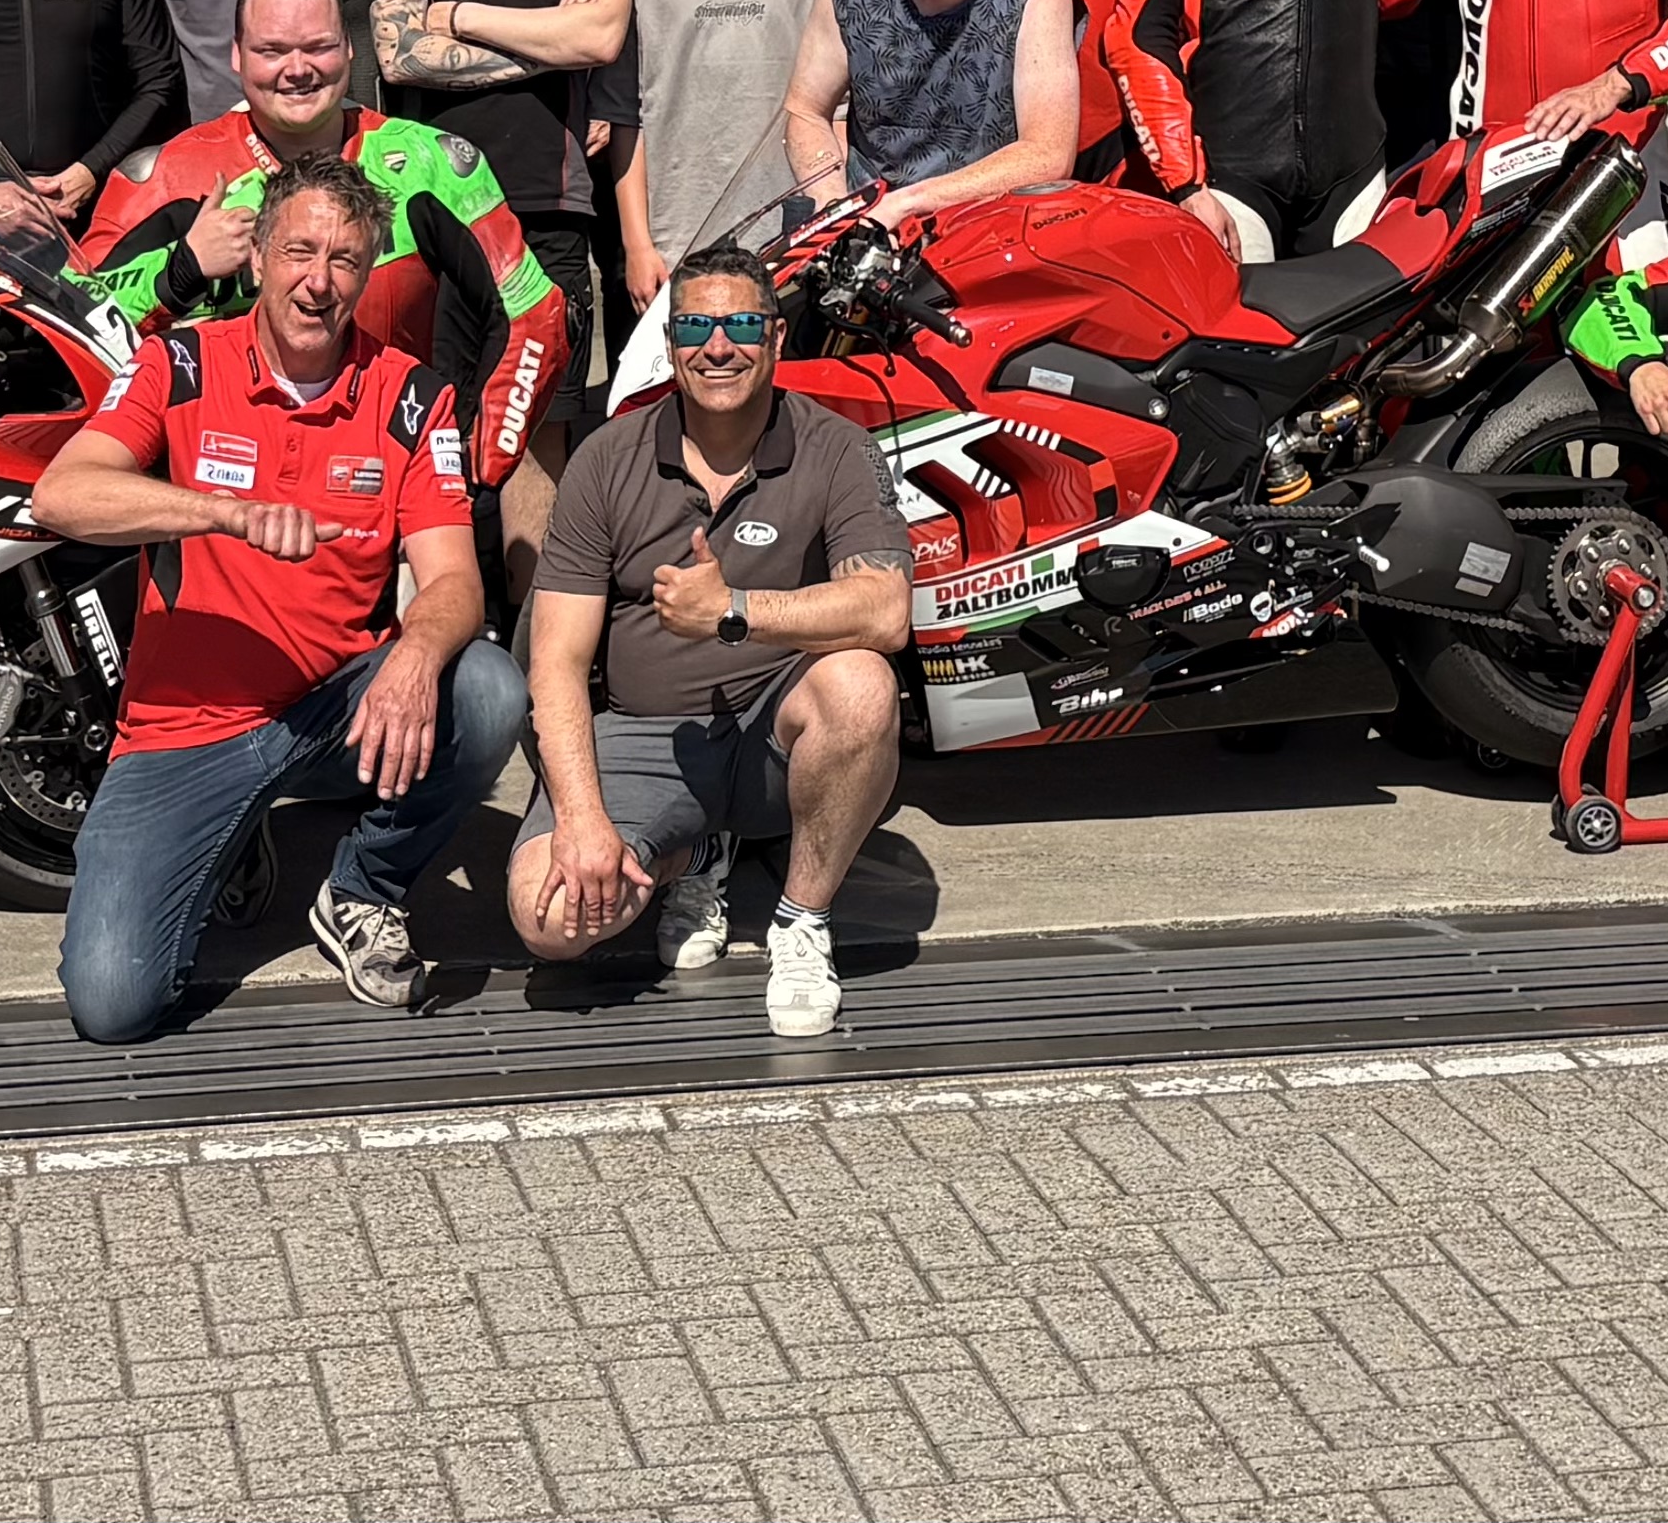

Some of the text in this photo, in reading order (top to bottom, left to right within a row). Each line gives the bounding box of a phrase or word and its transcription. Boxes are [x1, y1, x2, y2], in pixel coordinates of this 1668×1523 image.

[496, 338, 545, 455] DUCATI
[936, 560, 1026, 602] DUCATI
[937, 566, 1075, 620] ZALTBOMM
[75, 588, 123, 686] PIRELLI
